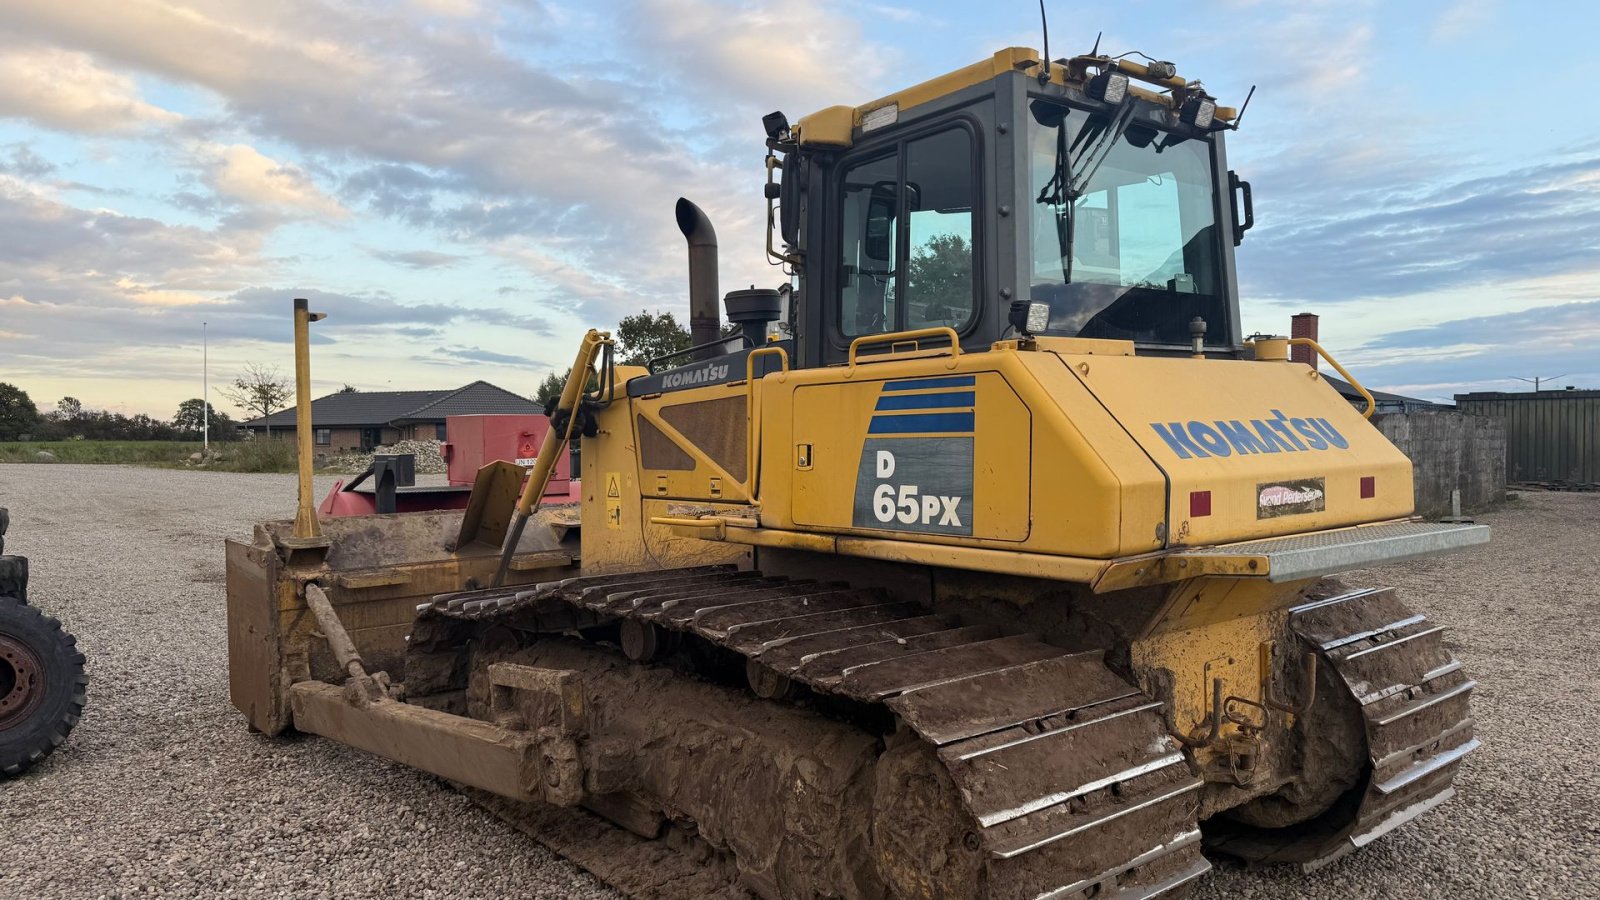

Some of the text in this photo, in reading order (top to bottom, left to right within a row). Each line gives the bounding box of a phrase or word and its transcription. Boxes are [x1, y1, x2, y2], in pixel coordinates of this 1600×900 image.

[662, 363, 729, 389] KOMATSU
[1149, 409, 1349, 459] KOMATSU
[876, 450, 896, 478] D
[873, 484, 962, 526] 65PX
